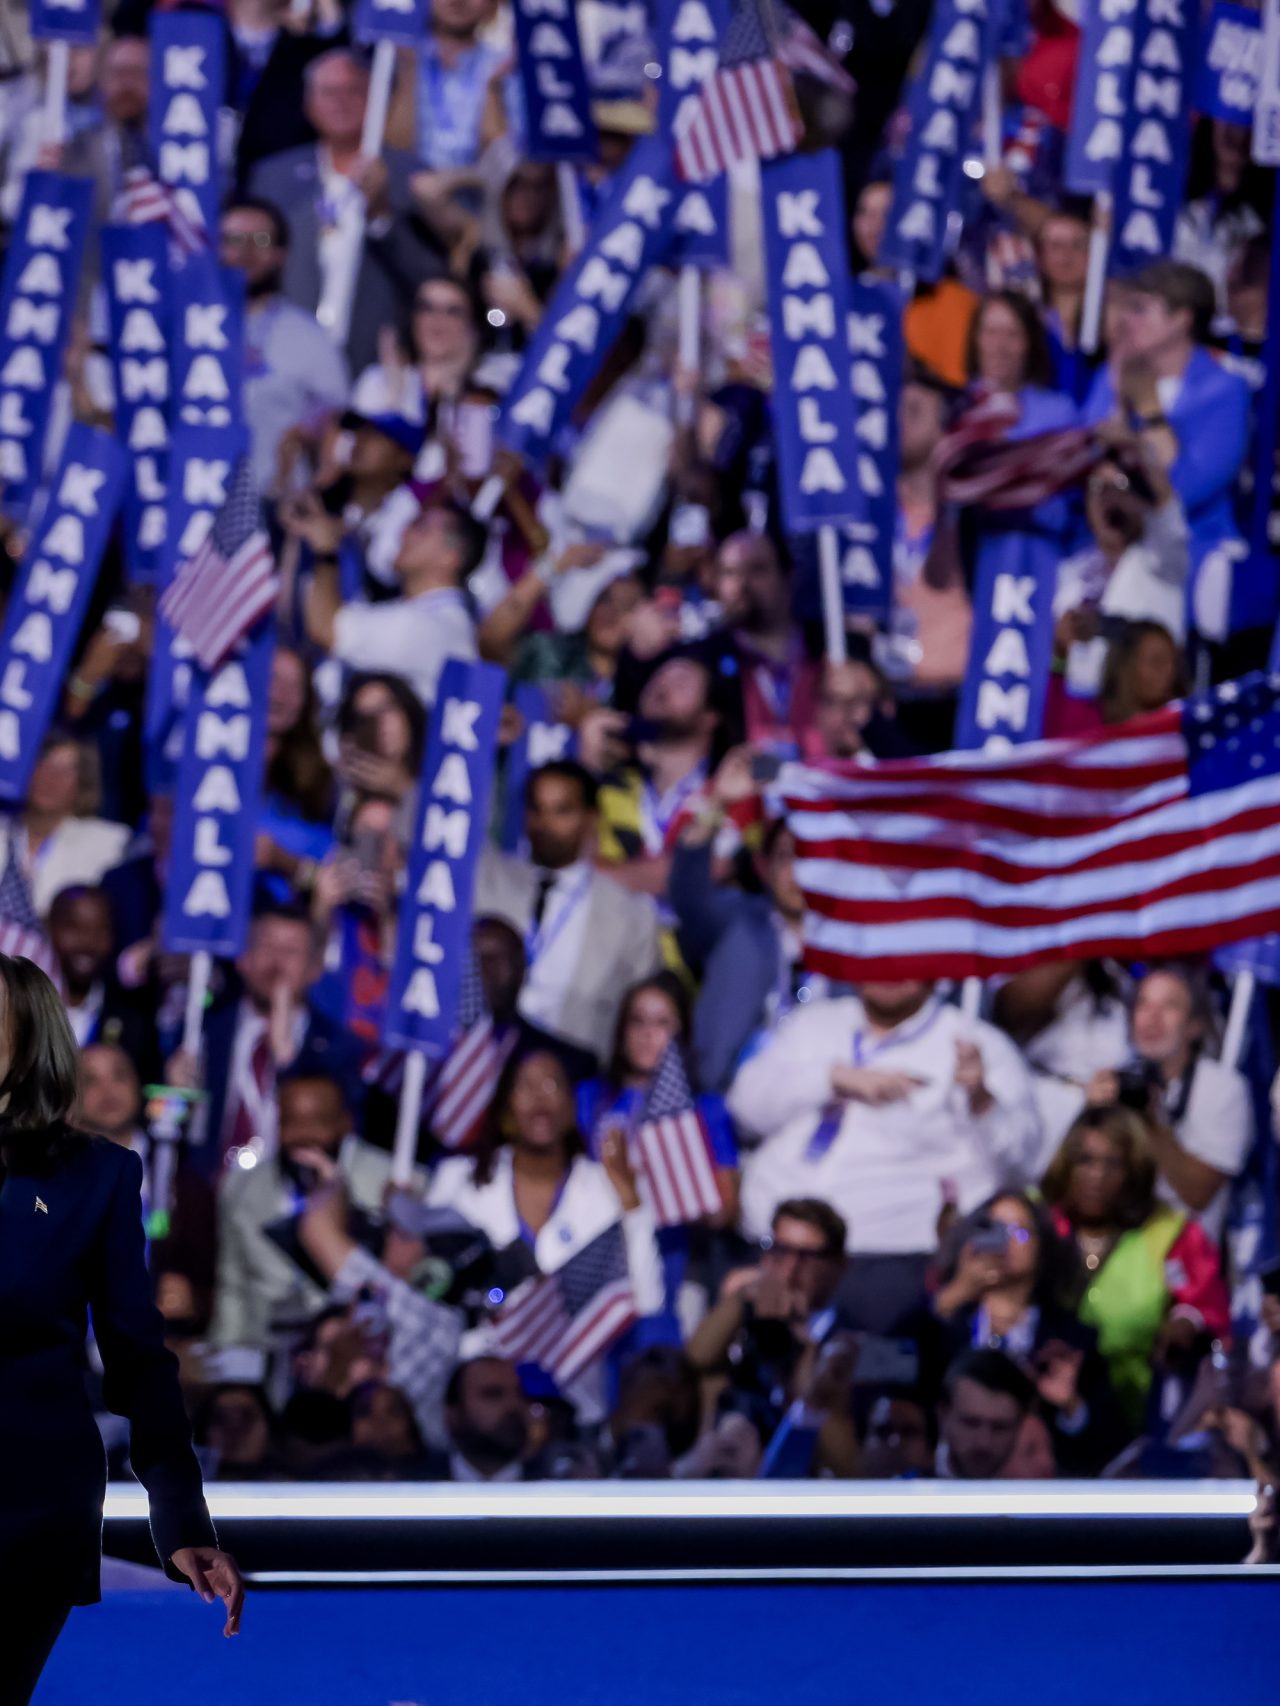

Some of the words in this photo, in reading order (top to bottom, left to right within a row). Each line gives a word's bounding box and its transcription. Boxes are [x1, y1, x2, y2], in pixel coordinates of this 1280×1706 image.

[510, 174, 671, 436] KAMALA
[775, 189, 847, 495] KAMALA
[182, 640, 251, 918] AMALA
[400, 698, 482, 1020] KAMALA
